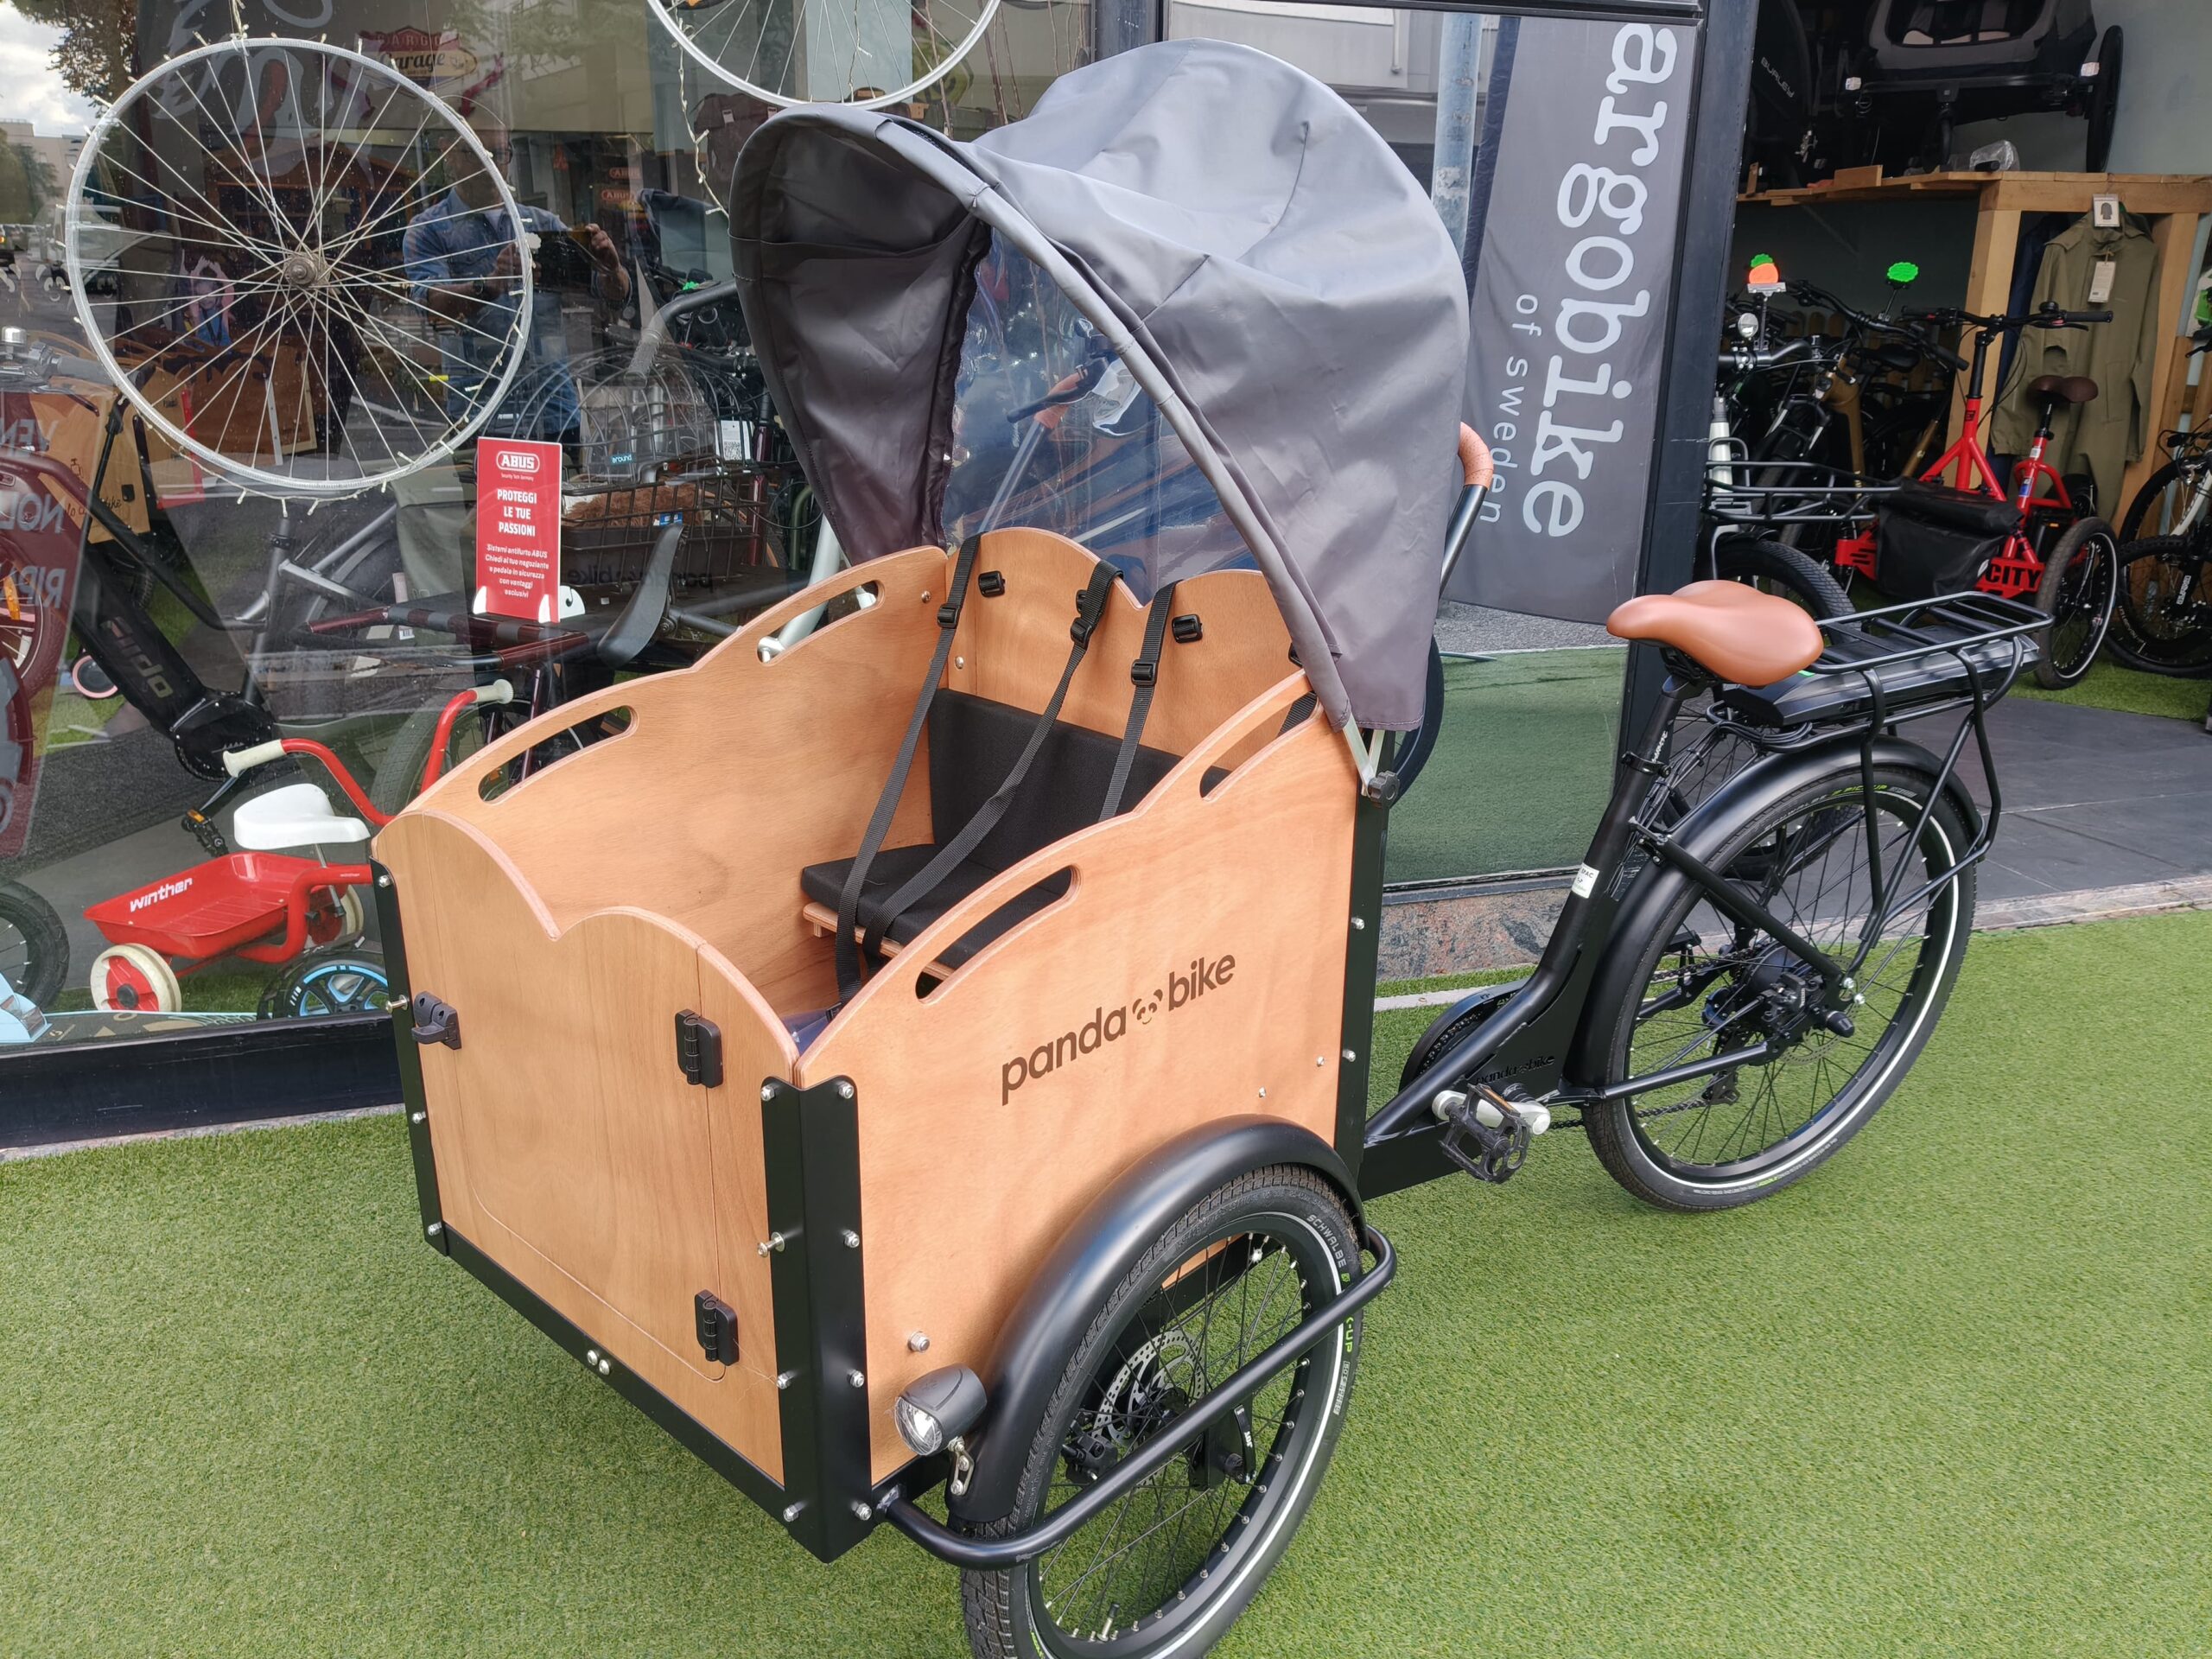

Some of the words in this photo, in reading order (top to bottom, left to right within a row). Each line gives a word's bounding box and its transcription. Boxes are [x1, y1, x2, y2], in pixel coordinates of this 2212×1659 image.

[1760, 56, 1796, 99] BURLEY
[1510, 293, 1542, 338] of
[1479, 356, 1528, 524] sweden
[501, 454, 535, 469] ABUS
[497, 488, 537, 505] PROTEGGI
[504, 505, 514, 518] LE
[515, 506, 531, 520] TUE
[499, 521, 536, 537] PASSIONI
[486, 543, 507, 553] Sistemi
[507, 547, 531, 556] antifurto
[531, 550, 548, 558] ABUS
[485, 554, 503, 563] Chiedi
[518, 560, 550, 570] negoziante
[518, 569, 545, 580] sicurezza
[1984, 563, 2043, 590] CITY
[510, 580, 533, 589] vantaggi
[504, 589, 529, 598] esclusivi
[130, 877, 194, 912] winther
[1001, 1006, 1127, 1107] panda
[1168, 954, 1236, 1012] bike
[1528, 1055, 1556, 1071] bike
[1306, 1214, 1347, 1268] SCHWALBE
